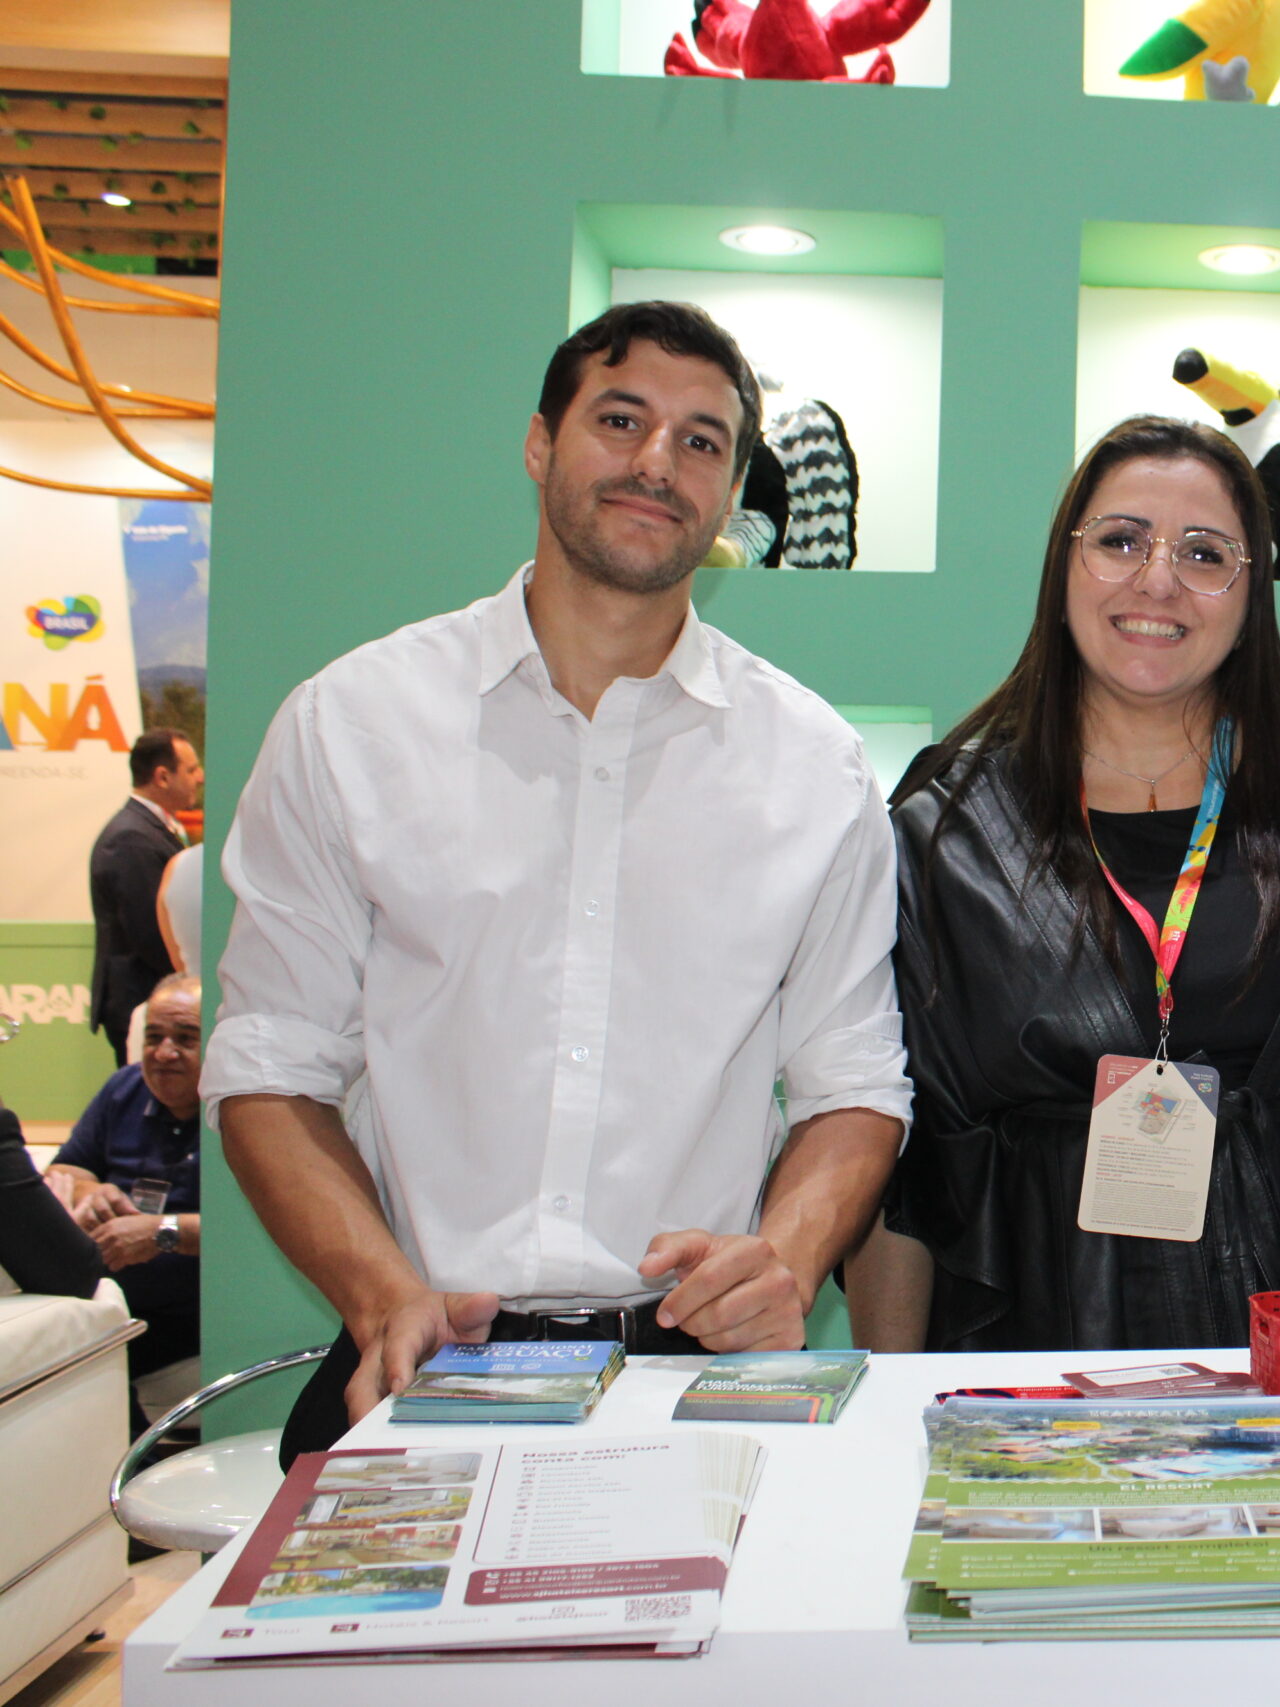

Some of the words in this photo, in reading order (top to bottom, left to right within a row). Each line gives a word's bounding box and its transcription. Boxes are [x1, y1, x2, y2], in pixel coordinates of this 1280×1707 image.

[43, 615, 90, 631] BRASIL
[0, 674, 130, 752] NÁ
[482, 1348, 594, 1358] IGUAÇU
[583, 1445, 670, 1455] estrutura
[1120, 1483, 1140, 1491] EL
[1144, 1481, 1213, 1491] RESORT
